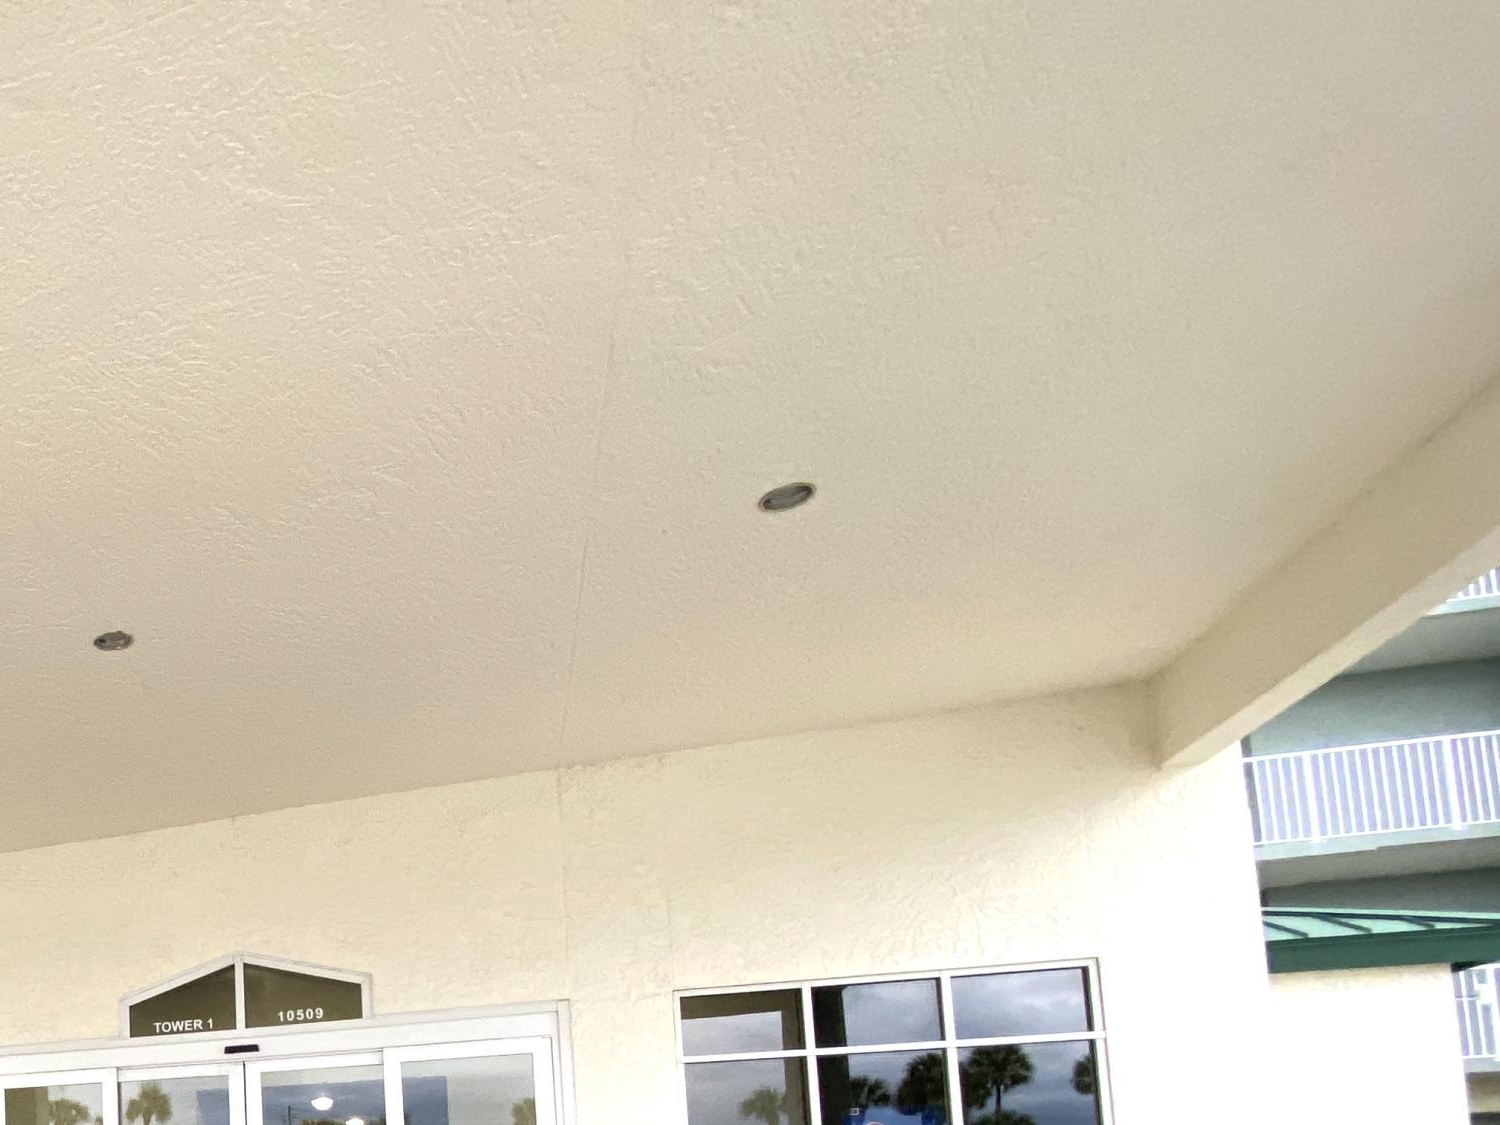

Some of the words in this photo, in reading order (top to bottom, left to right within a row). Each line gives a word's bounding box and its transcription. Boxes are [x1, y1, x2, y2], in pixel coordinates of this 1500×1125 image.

[277, 1007, 324, 1022] 10509
[153, 1019, 203, 1033] TOWER
[207, 1018, 213, 1029] 1
